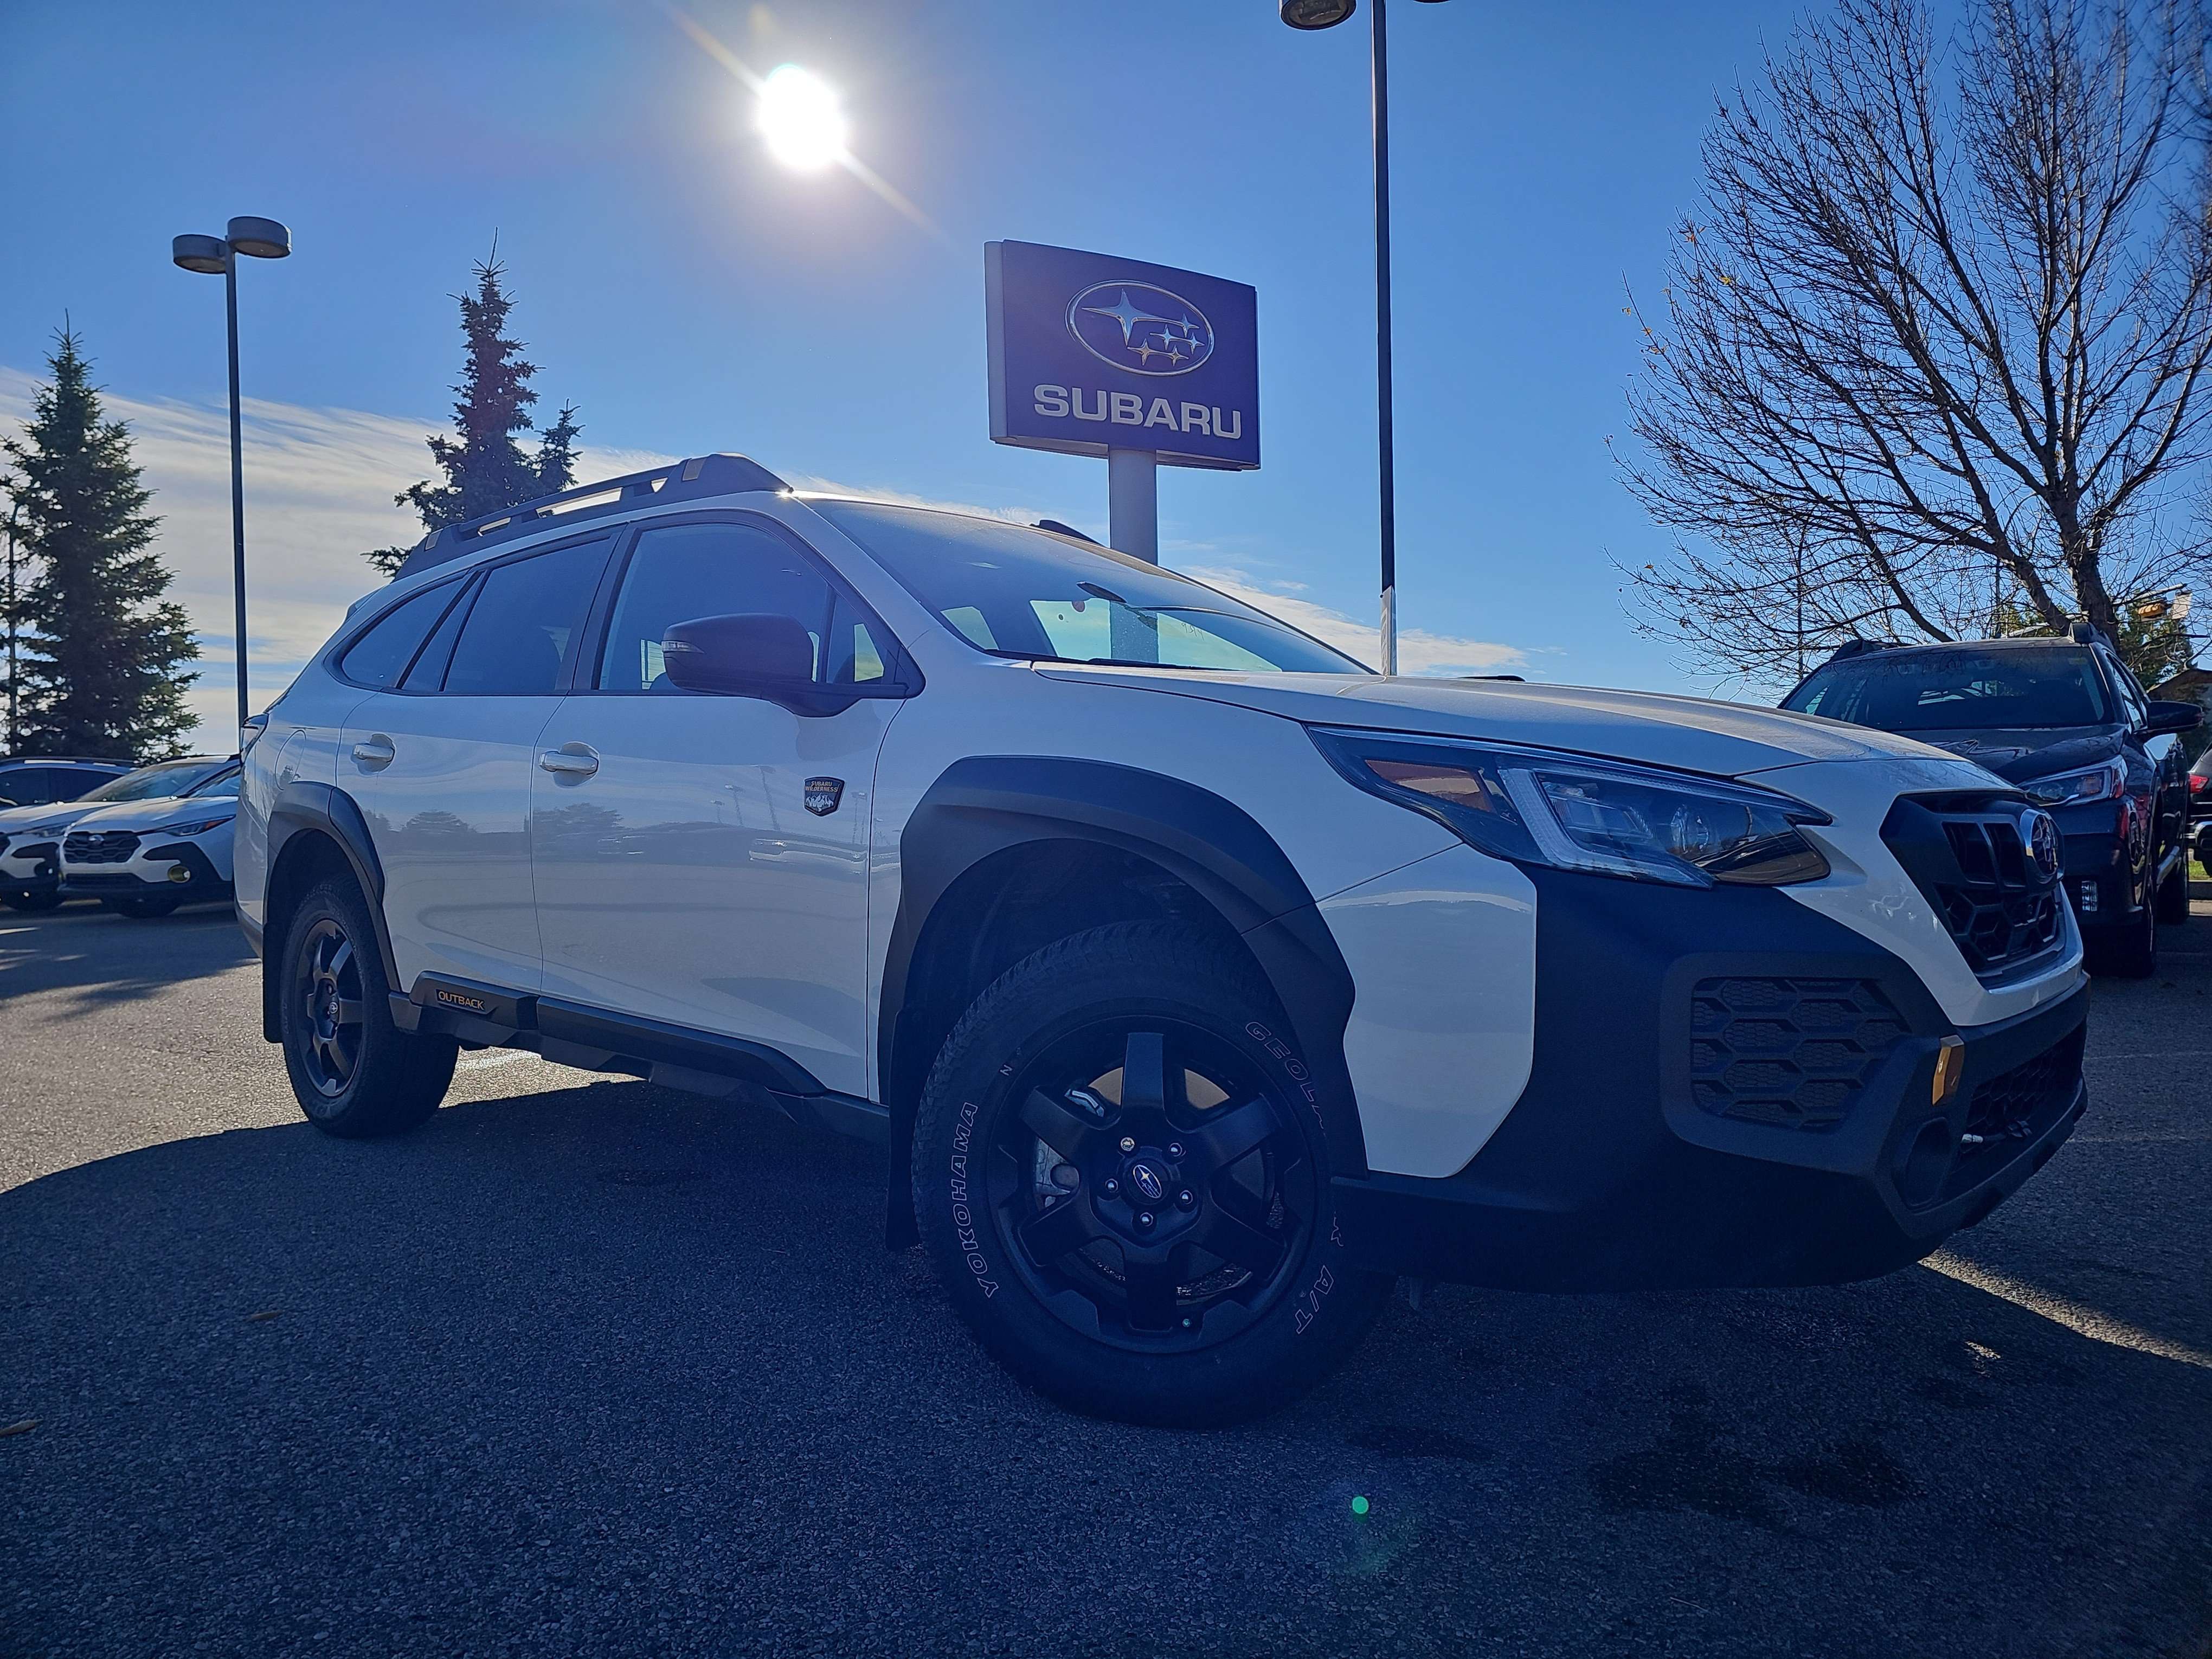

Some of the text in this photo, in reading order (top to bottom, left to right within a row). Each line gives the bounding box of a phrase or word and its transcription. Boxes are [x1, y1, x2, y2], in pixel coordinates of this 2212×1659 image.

[1033, 384, 1242, 440] SUBARU
[438, 991, 485, 1011] OUTBACK
[950, 1102, 999, 1298] YOKOHAMA
[1294, 1264, 1335, 1335] A/T
